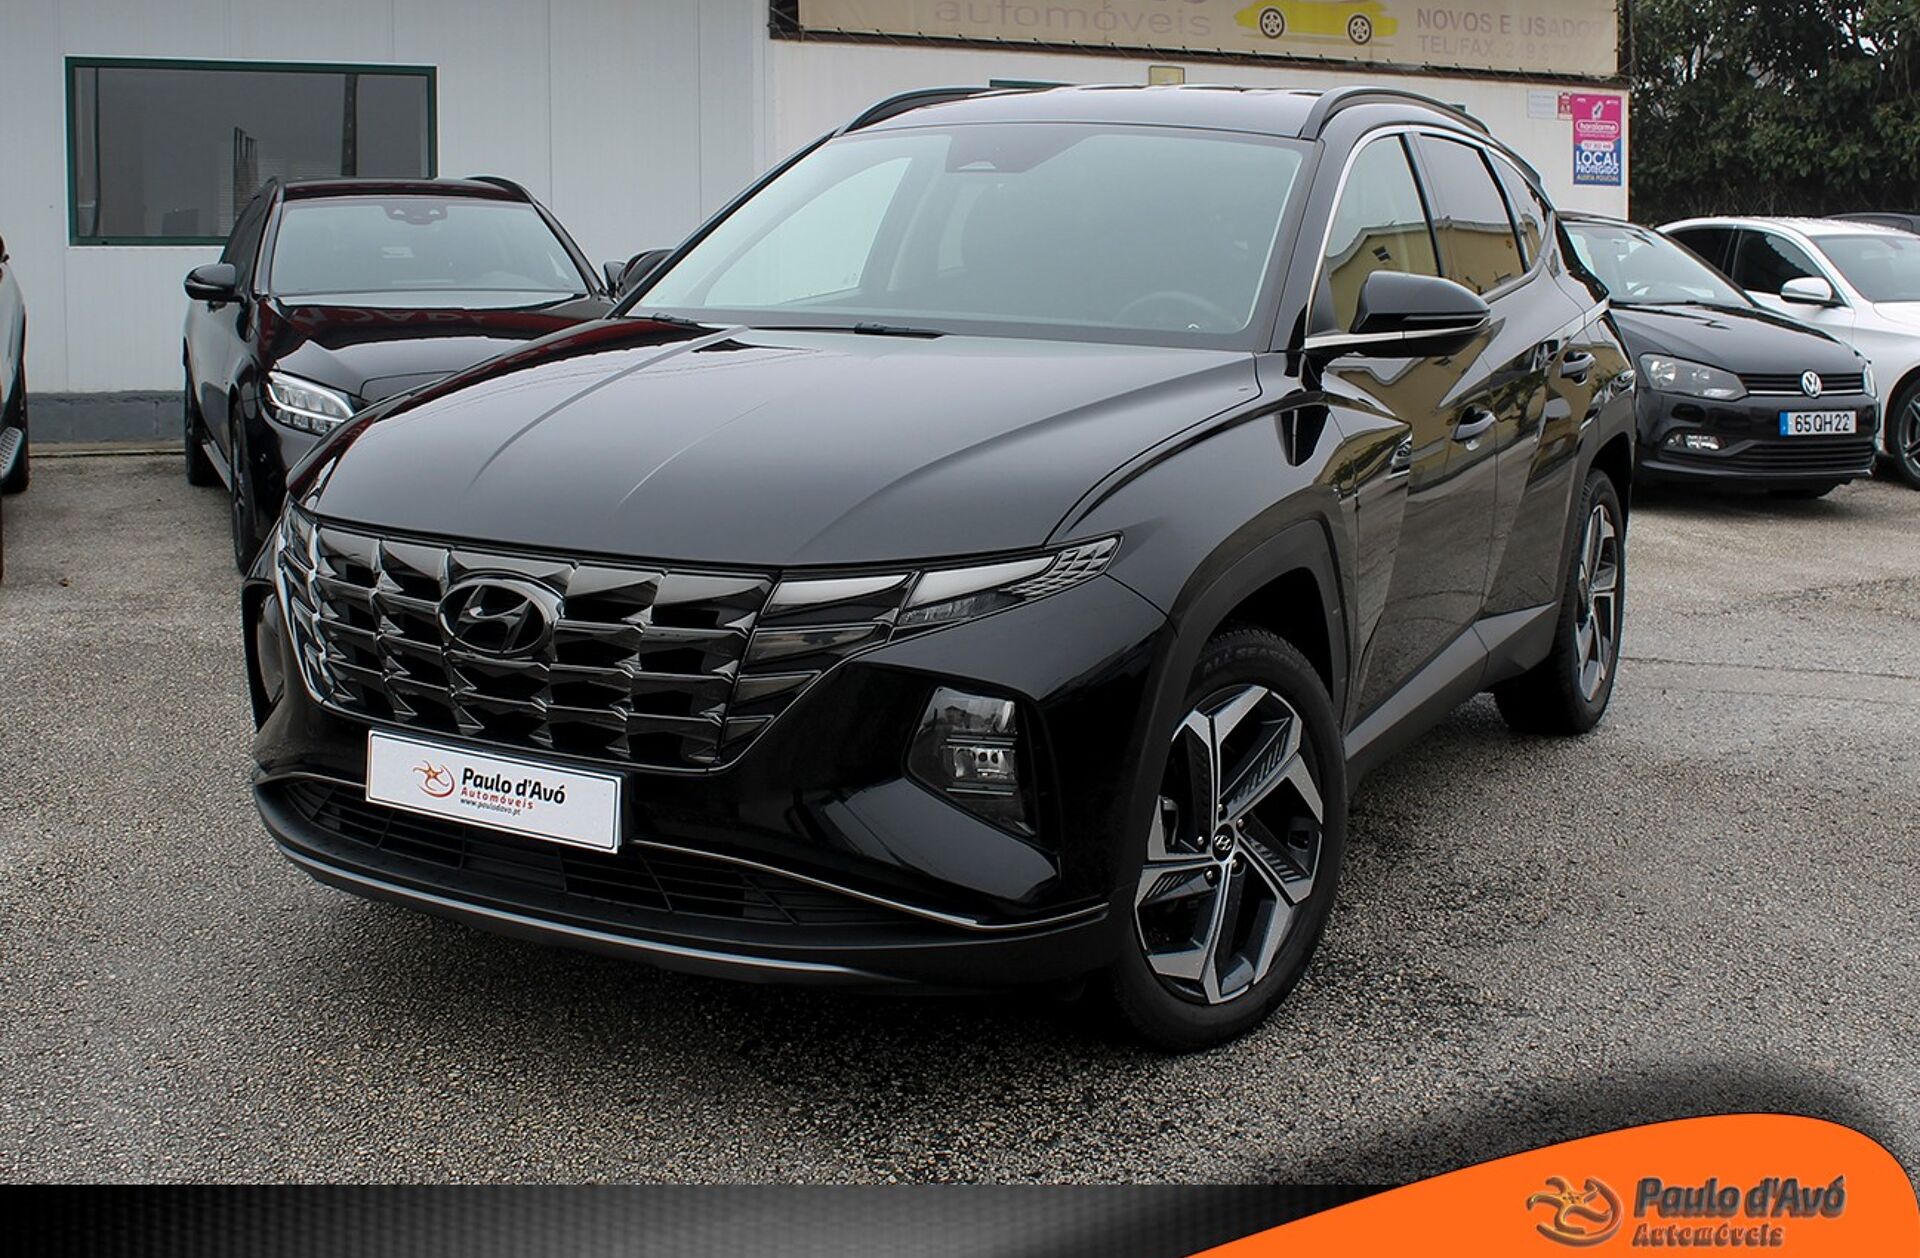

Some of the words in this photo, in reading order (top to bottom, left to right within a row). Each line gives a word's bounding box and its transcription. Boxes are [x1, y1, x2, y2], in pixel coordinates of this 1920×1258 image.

[935, 0, 1212, 36] automóveis
[1417, 8, 1493, 34] NOVOS
[1499, 15, 1511, 35] E
[1576, 151, 1619, 166] LOCAL
[1576, 164, 1619, 175] PROTEGIDO
[462, 767, 512, 795] Paulo
[515, 778, 565, 805] d'Avó
[460, 787, 534, 810] Automóveis
[460, 798, 521, 816] www.paulodavo.pt
